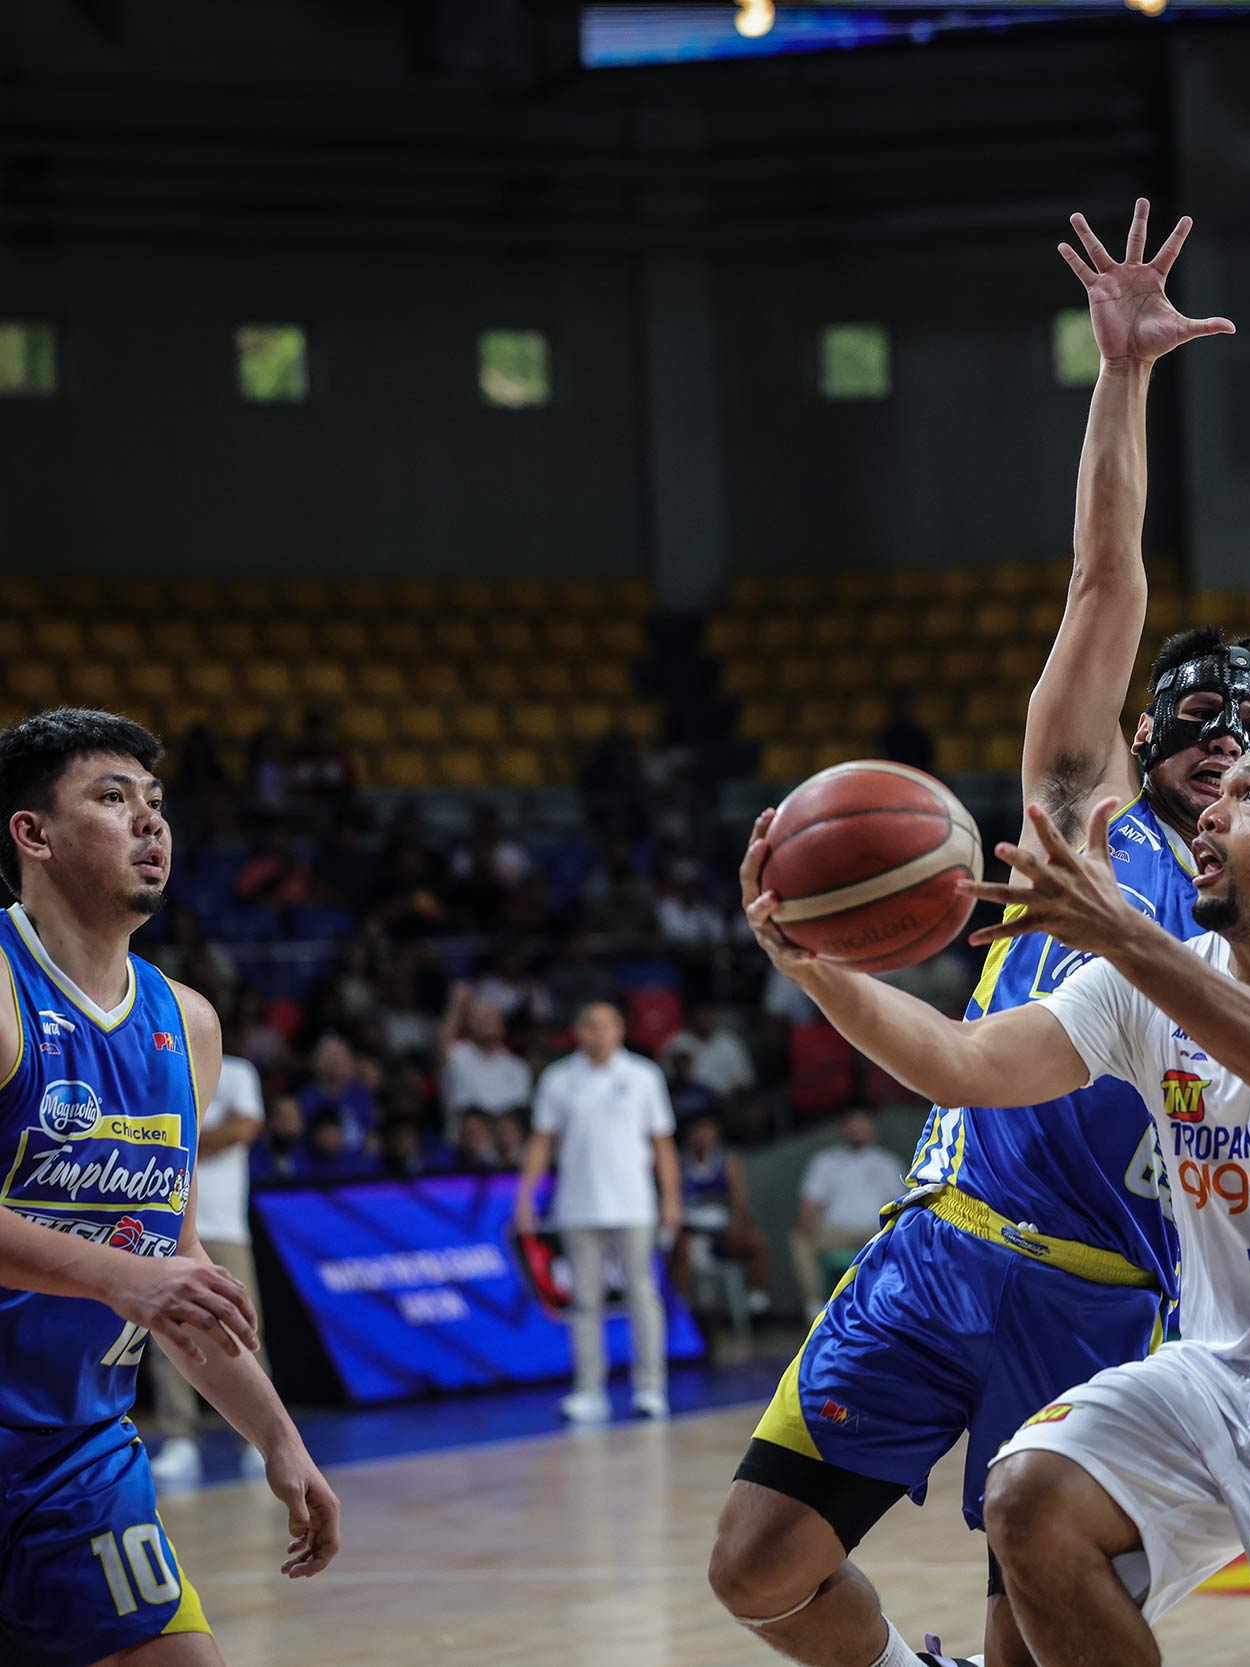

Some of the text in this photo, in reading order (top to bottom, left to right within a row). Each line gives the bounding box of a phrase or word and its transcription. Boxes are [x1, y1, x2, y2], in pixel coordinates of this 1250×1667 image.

[1118, 824, 1147, 845] ANTA
[40, 1092, 99, 1132] Magnolia
[1160, 1079, 1212, 1114] TNT
[111, 1120, 168, 1143] Chicken
[24, 1145, 174, 1201] Timplados
[90, 1523, 181, 1616] 10
